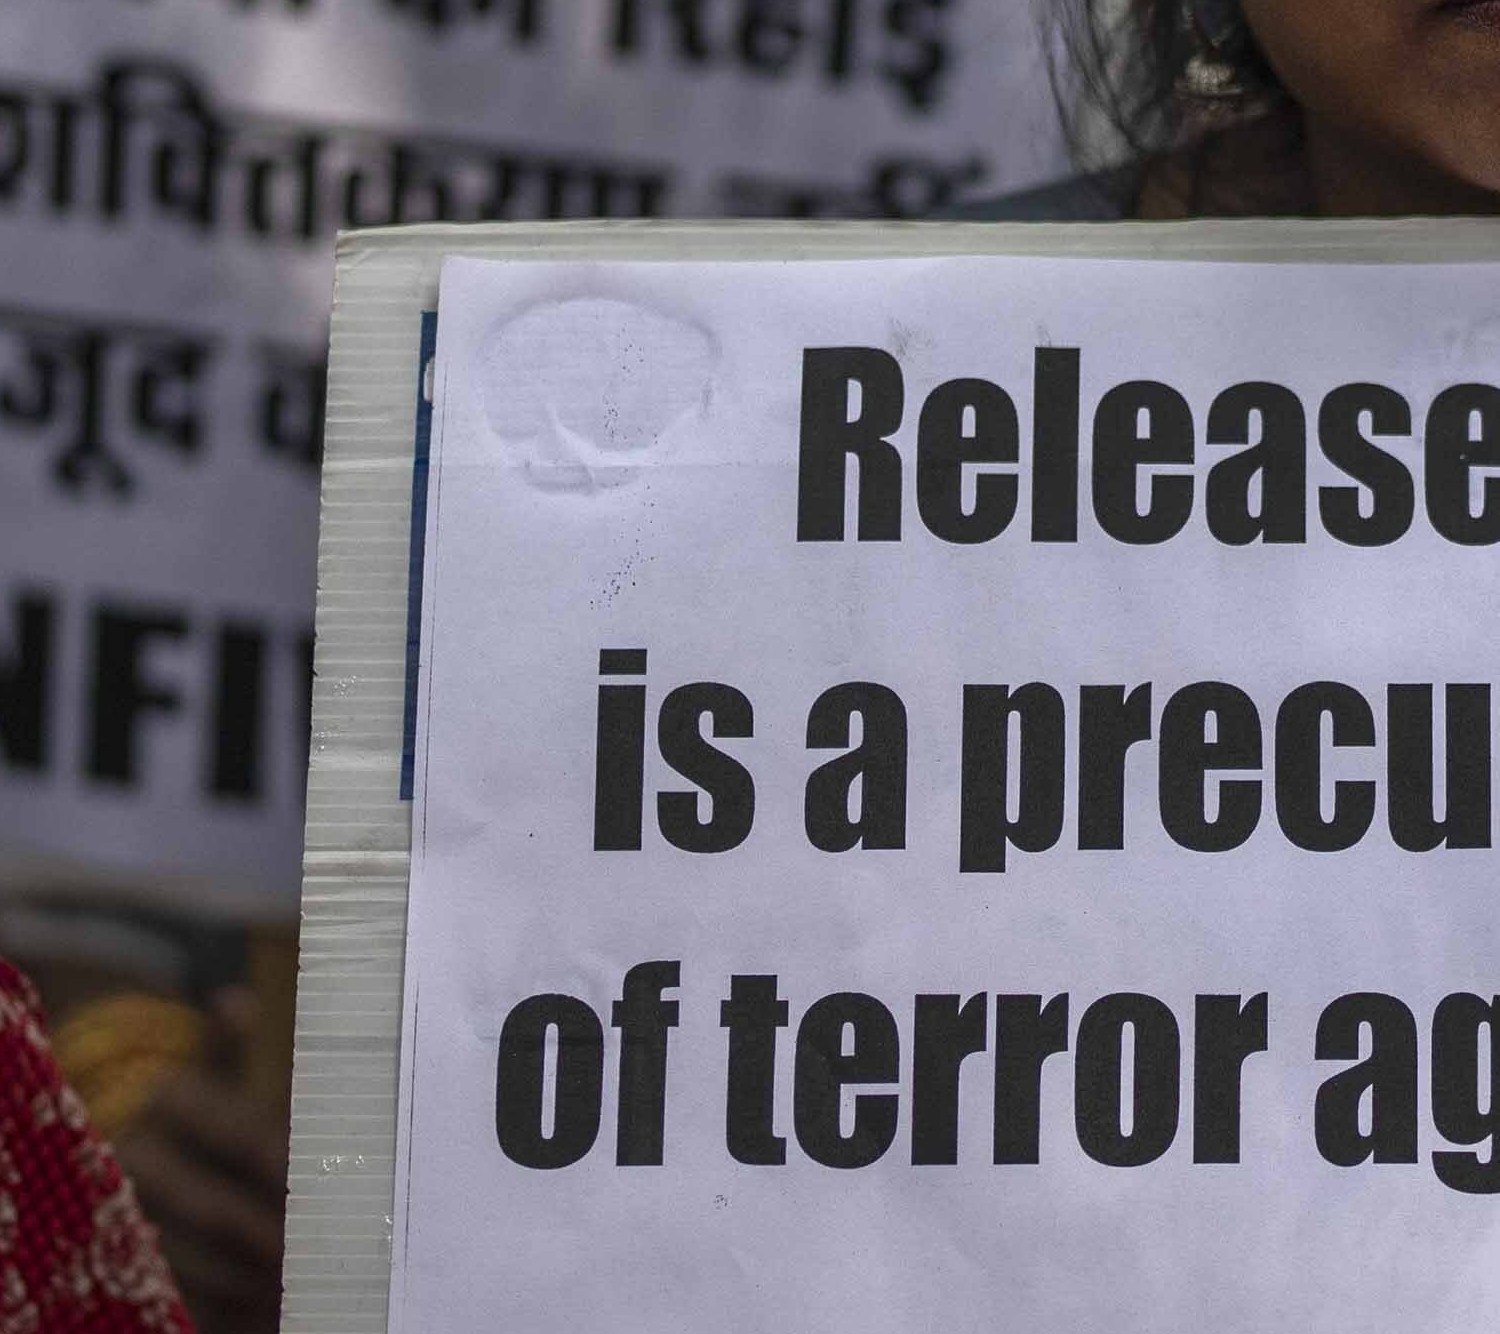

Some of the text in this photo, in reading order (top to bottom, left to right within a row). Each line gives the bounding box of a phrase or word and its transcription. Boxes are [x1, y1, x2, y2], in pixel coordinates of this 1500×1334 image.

[593, 648, 756, 854] is
[804, 681, 908, 854] a
[495, 960, 682, 1171] of
[719, 974, 1270, 1170] terror
